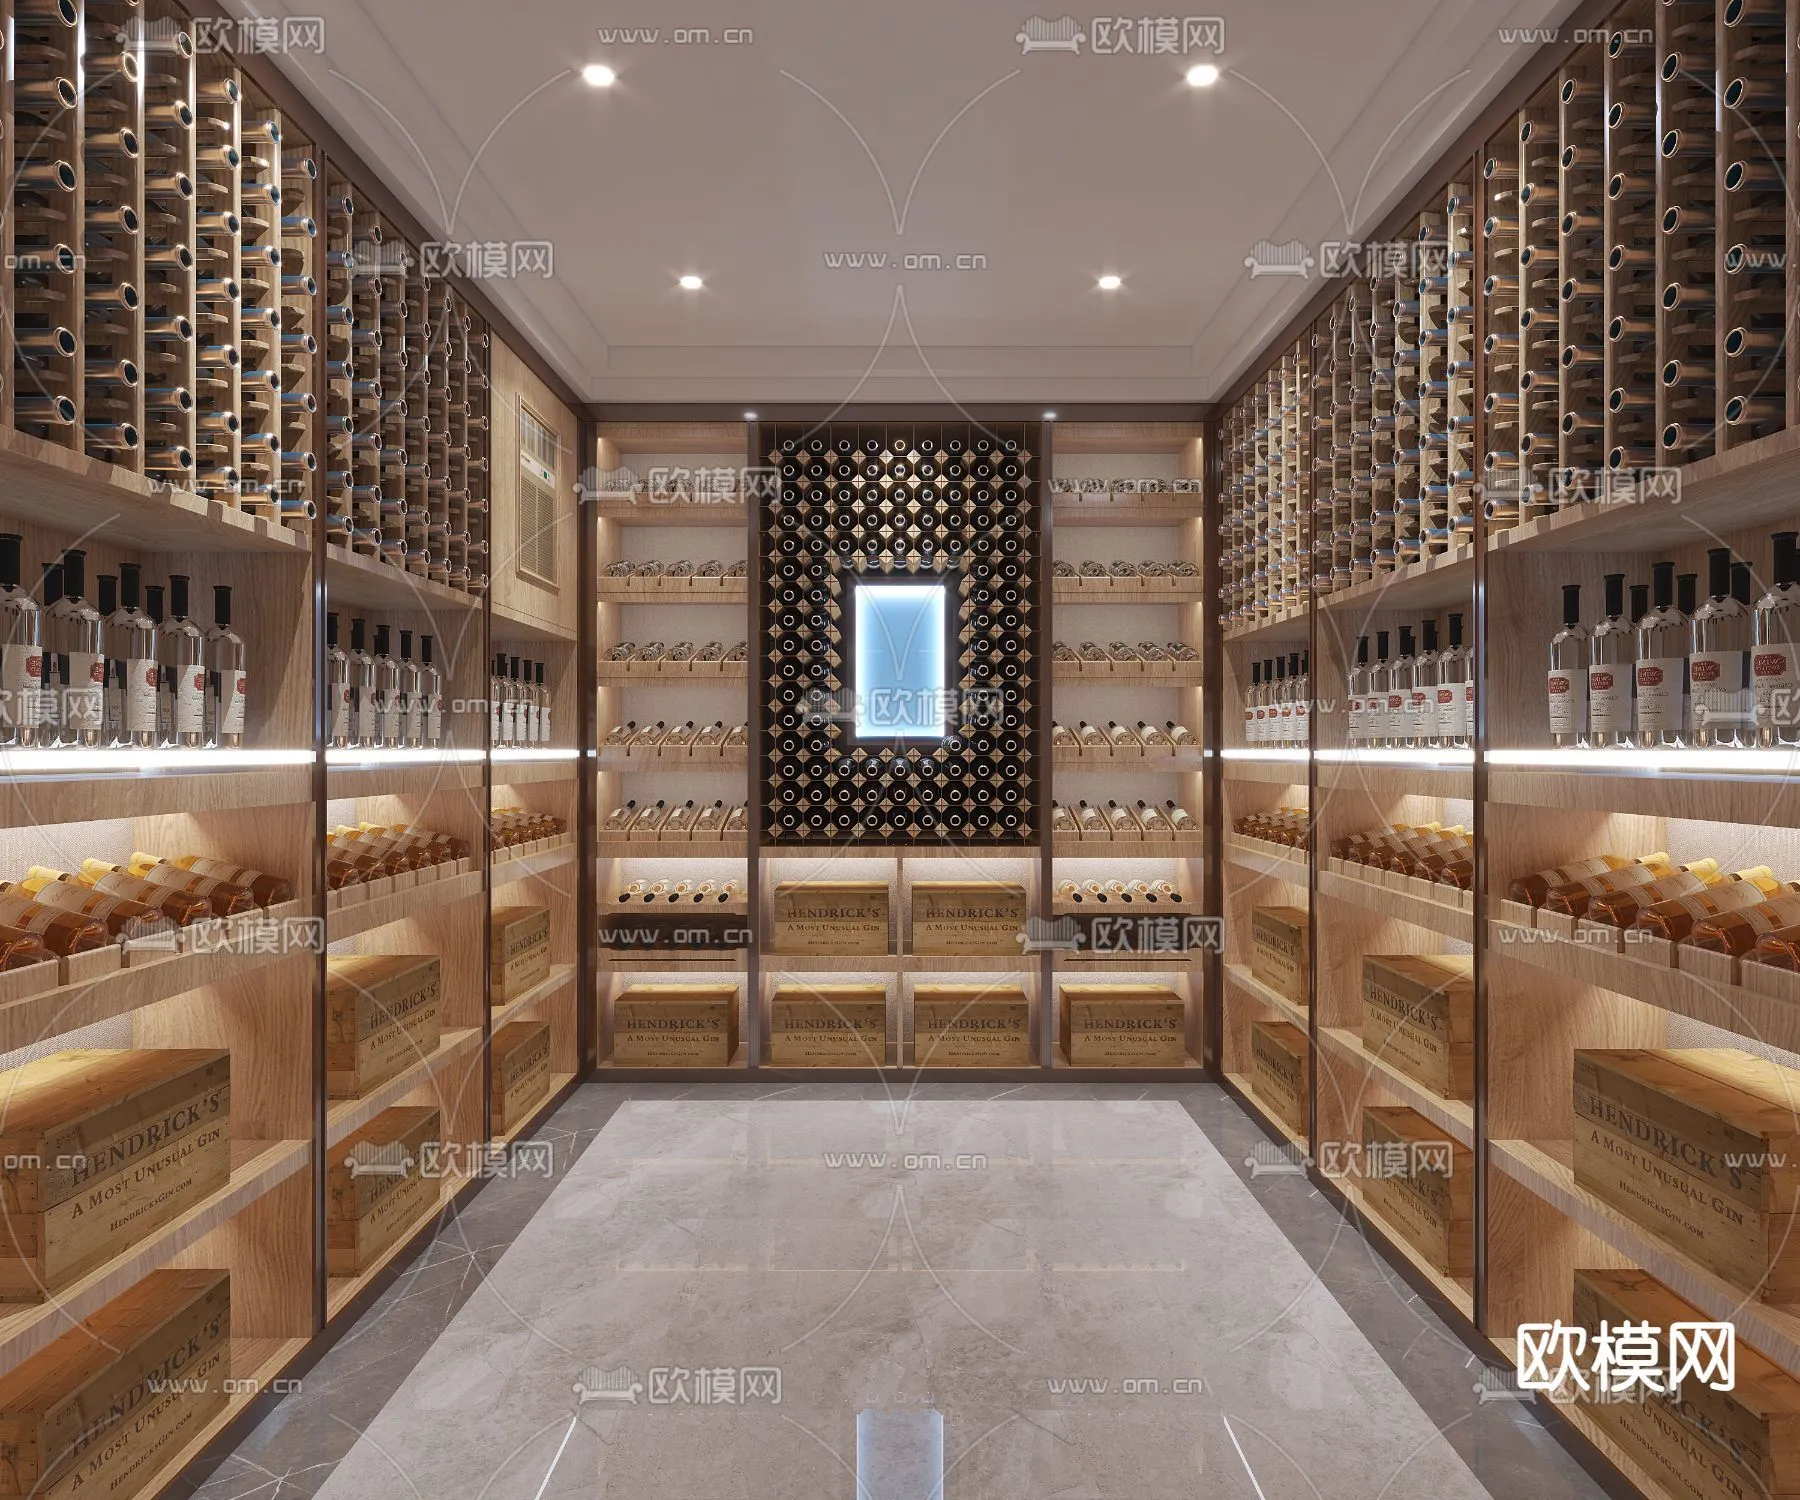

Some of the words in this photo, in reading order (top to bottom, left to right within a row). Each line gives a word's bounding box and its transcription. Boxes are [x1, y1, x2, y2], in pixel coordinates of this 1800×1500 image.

[787, 907, 880, 918] HENDRICK'S
[926, 907, 1019, 918] HENDRICK'S
[627, 1019, 720, 1029] HENDRICK'S
[785, 1019, 877, 1029] HENDRICK'S
[928, 1019, 1021, 1029] HENDRICK'S
[1084, 1019, 1177, 1029] HENDRICK'S
[72, 1092, 220, 1187] HENDRICK'S
[1589, 1096, 1743, 1189] HENDRICK'S
